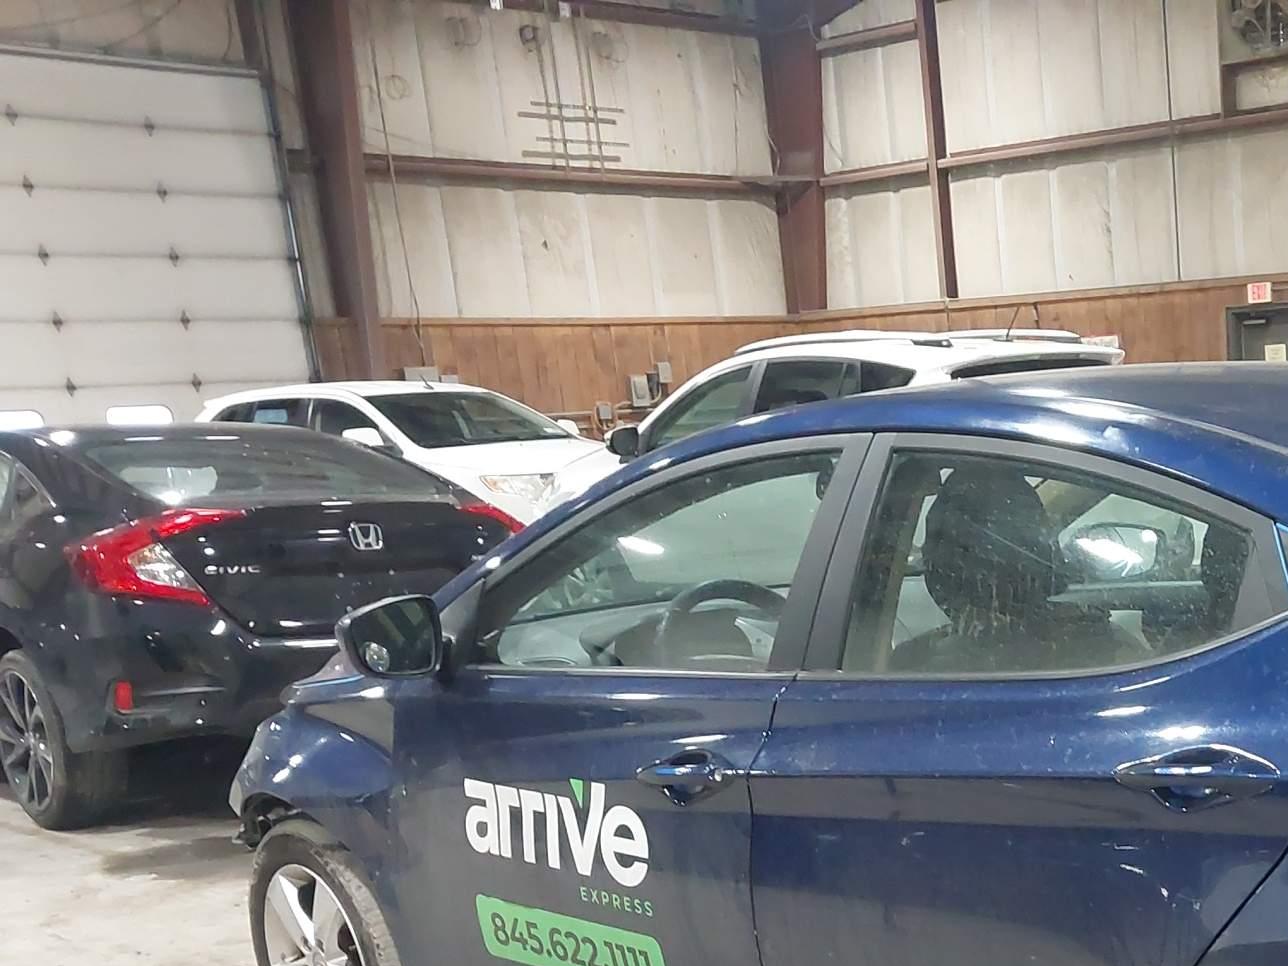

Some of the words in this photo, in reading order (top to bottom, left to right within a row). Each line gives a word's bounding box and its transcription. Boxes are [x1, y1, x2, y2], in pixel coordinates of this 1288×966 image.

[204, 565, 262, 576] CIVIC
[463, 778, 650, 888] arrive
[579, 886, 654, 917] EXPRESS
